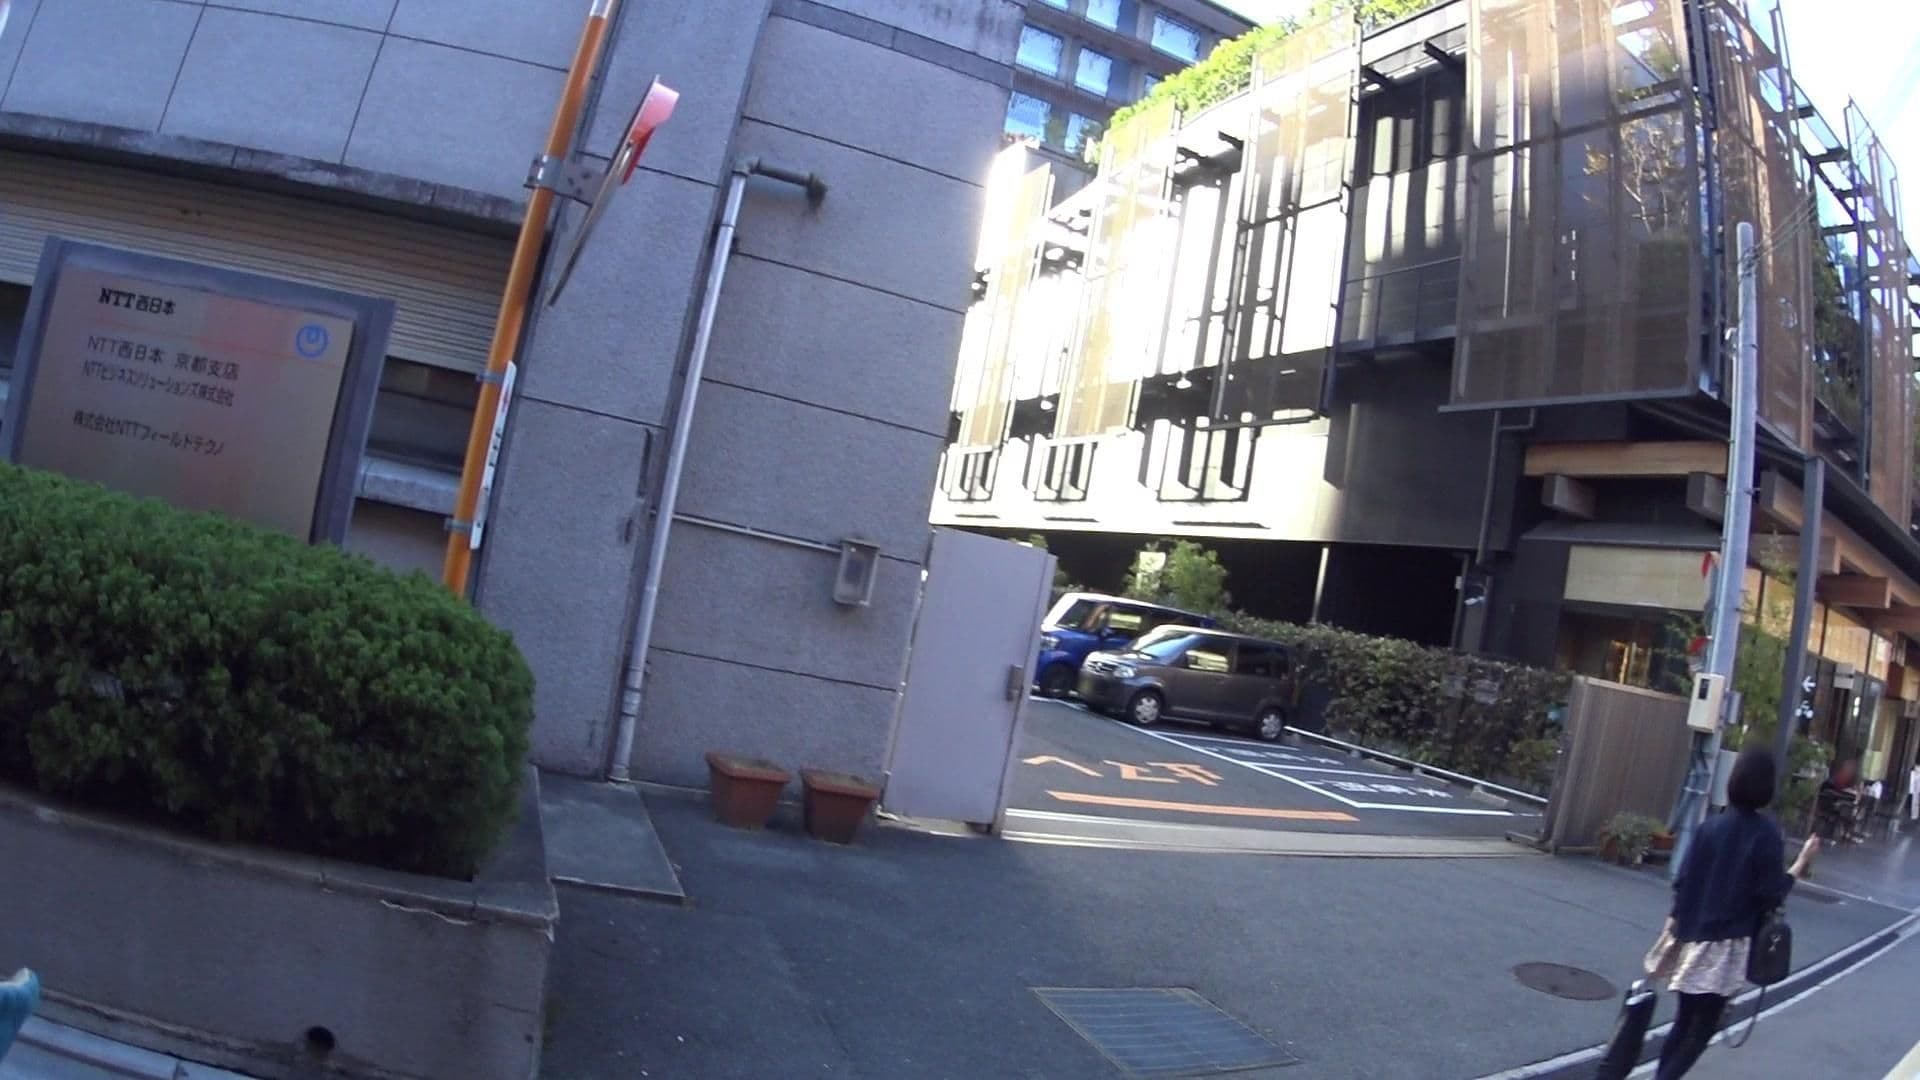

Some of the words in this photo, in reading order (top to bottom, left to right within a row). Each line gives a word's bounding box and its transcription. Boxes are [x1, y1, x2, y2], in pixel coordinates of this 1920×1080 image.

[98, 287, 176, 315] NTT西日本
[87, 335, 165, 364] NTT西日本
[174, 352, 240, 381] 京都支店
[73, 411, 225, 457] 株式会社NTTフィールドテクノ
